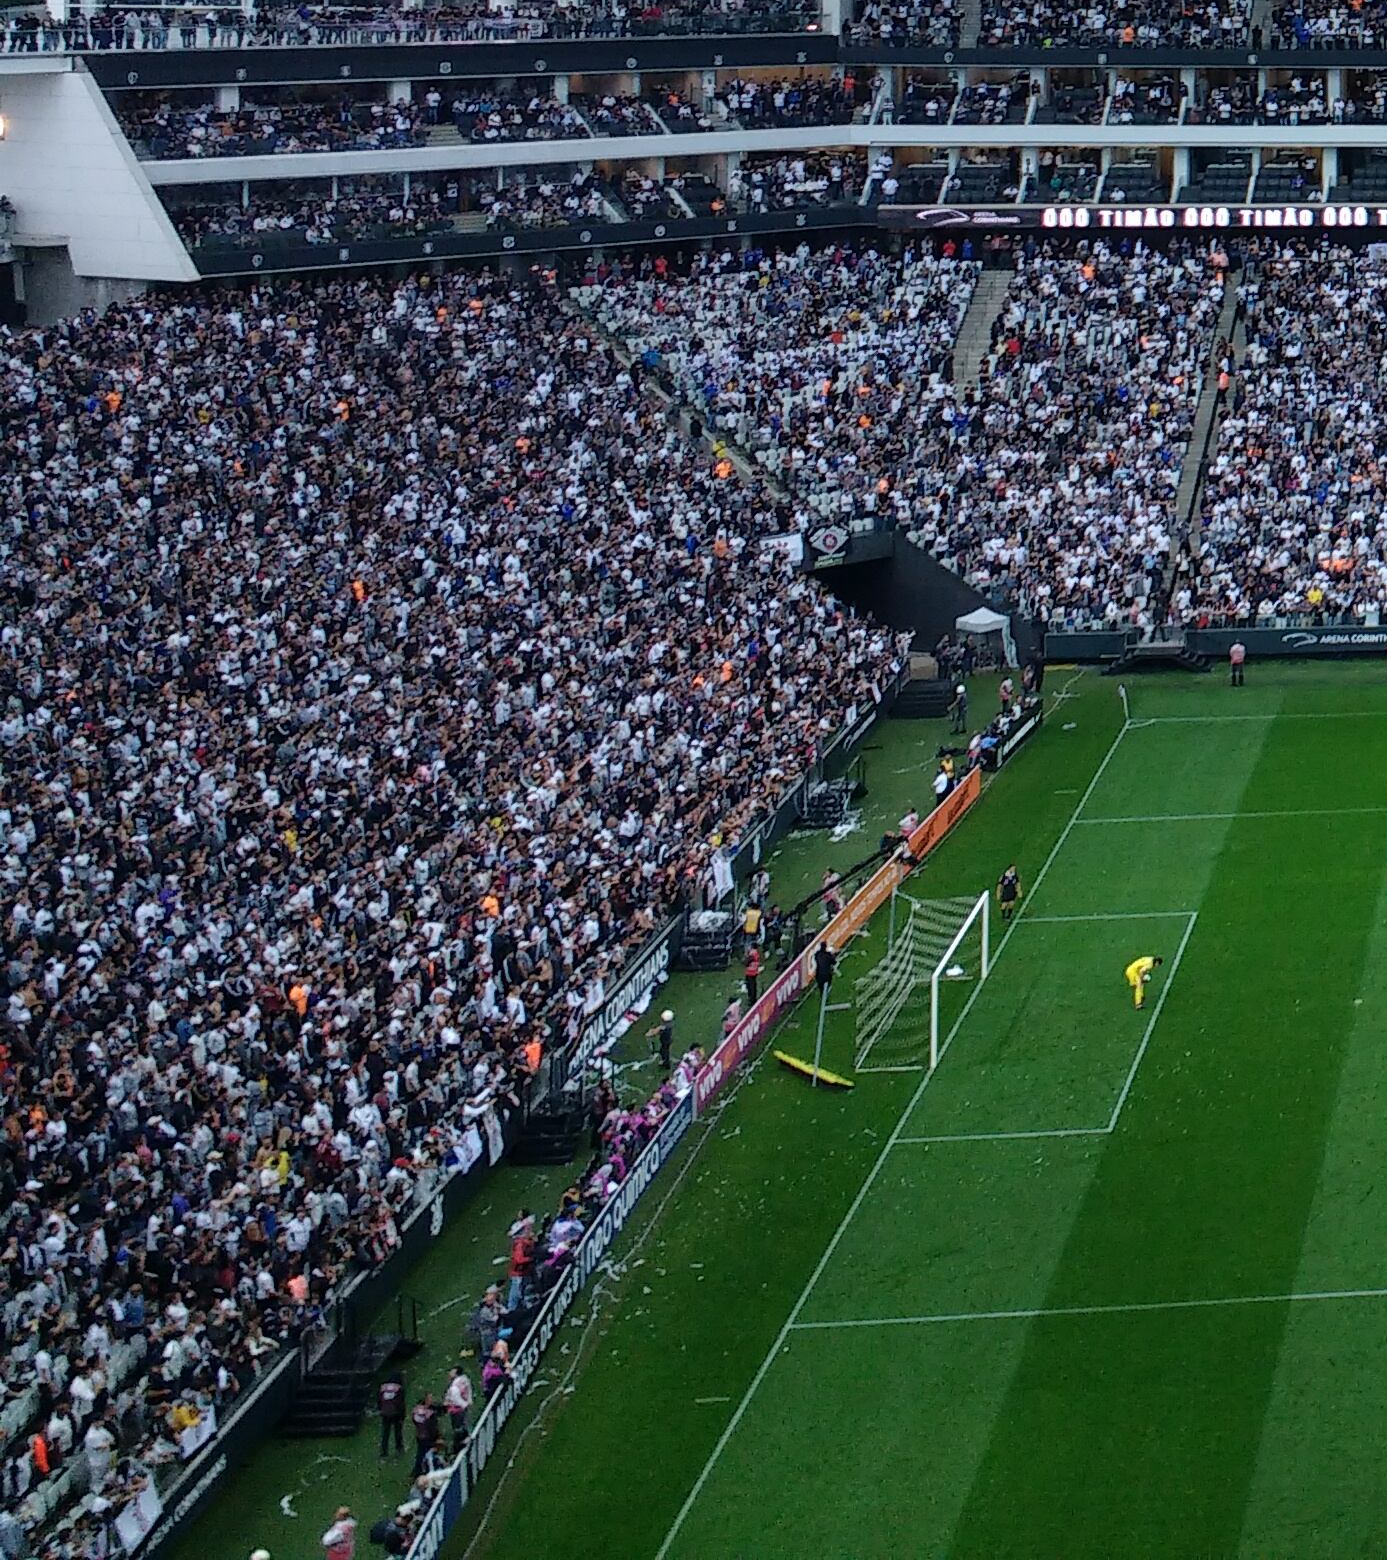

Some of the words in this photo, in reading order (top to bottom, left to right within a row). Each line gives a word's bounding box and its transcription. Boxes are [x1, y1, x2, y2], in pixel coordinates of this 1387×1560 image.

[1099, 207, 1175, 227] TIMÃO
[1240, 207, 1313, 226] TIMÃO
[1319, 633, 1350, 644] ARENA
[604, 939, 669, 1030] CORINTHIANS
